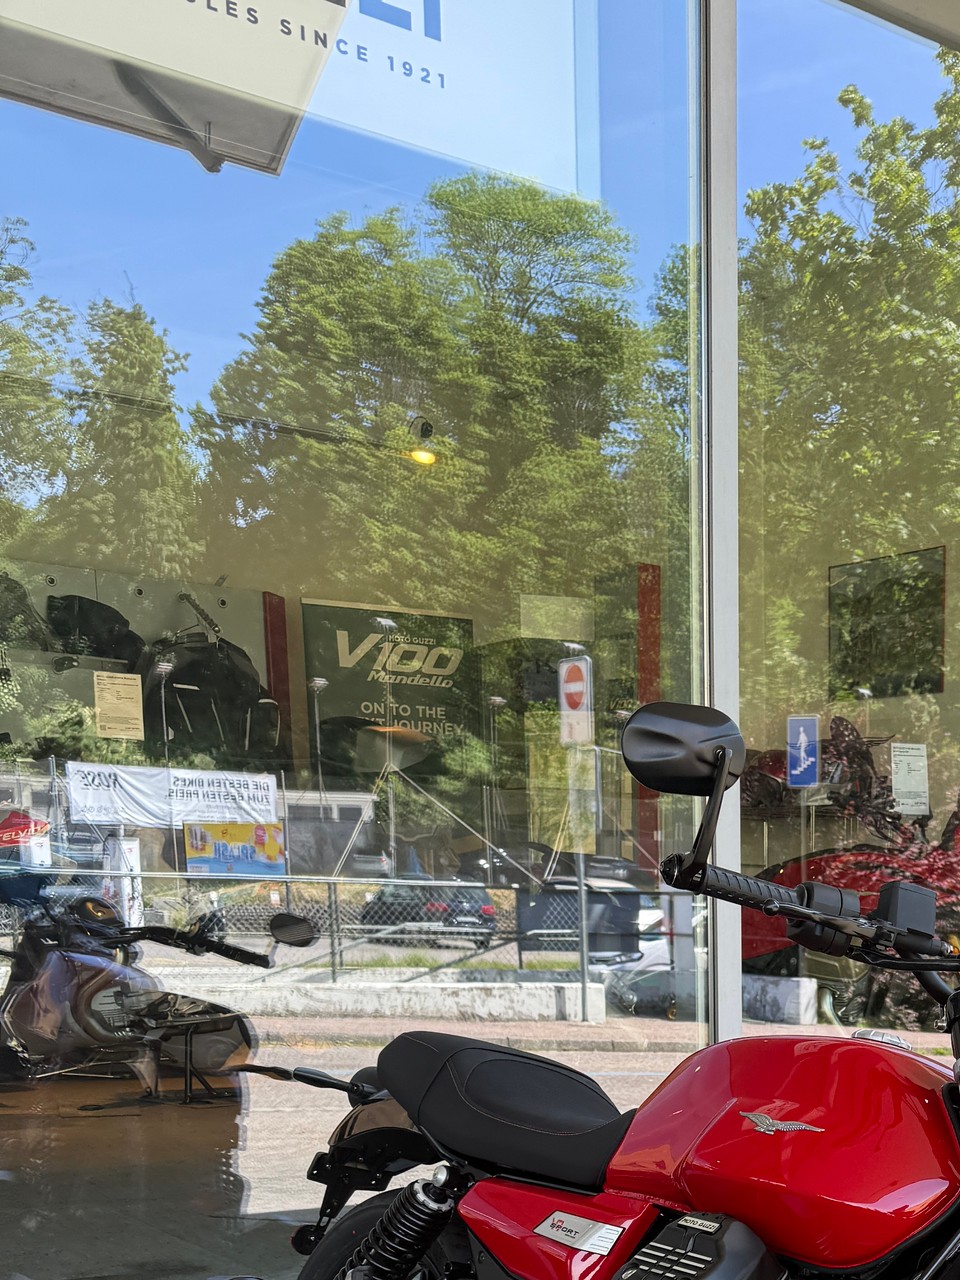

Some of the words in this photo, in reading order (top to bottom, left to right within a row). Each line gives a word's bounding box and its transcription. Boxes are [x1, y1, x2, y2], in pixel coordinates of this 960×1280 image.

[279, 18, 369, 63] SINCE
[387, 55, 446, 89] 1921
[336, 630, 464, 675] V100
[367, 670, 454, 688] Mandello
[360, 701, 385, 715] ON
[389, 703, 411, 717] TO
[415, 705, 446, 719] THE
[549, 1222, 580, 1236] SPORT
